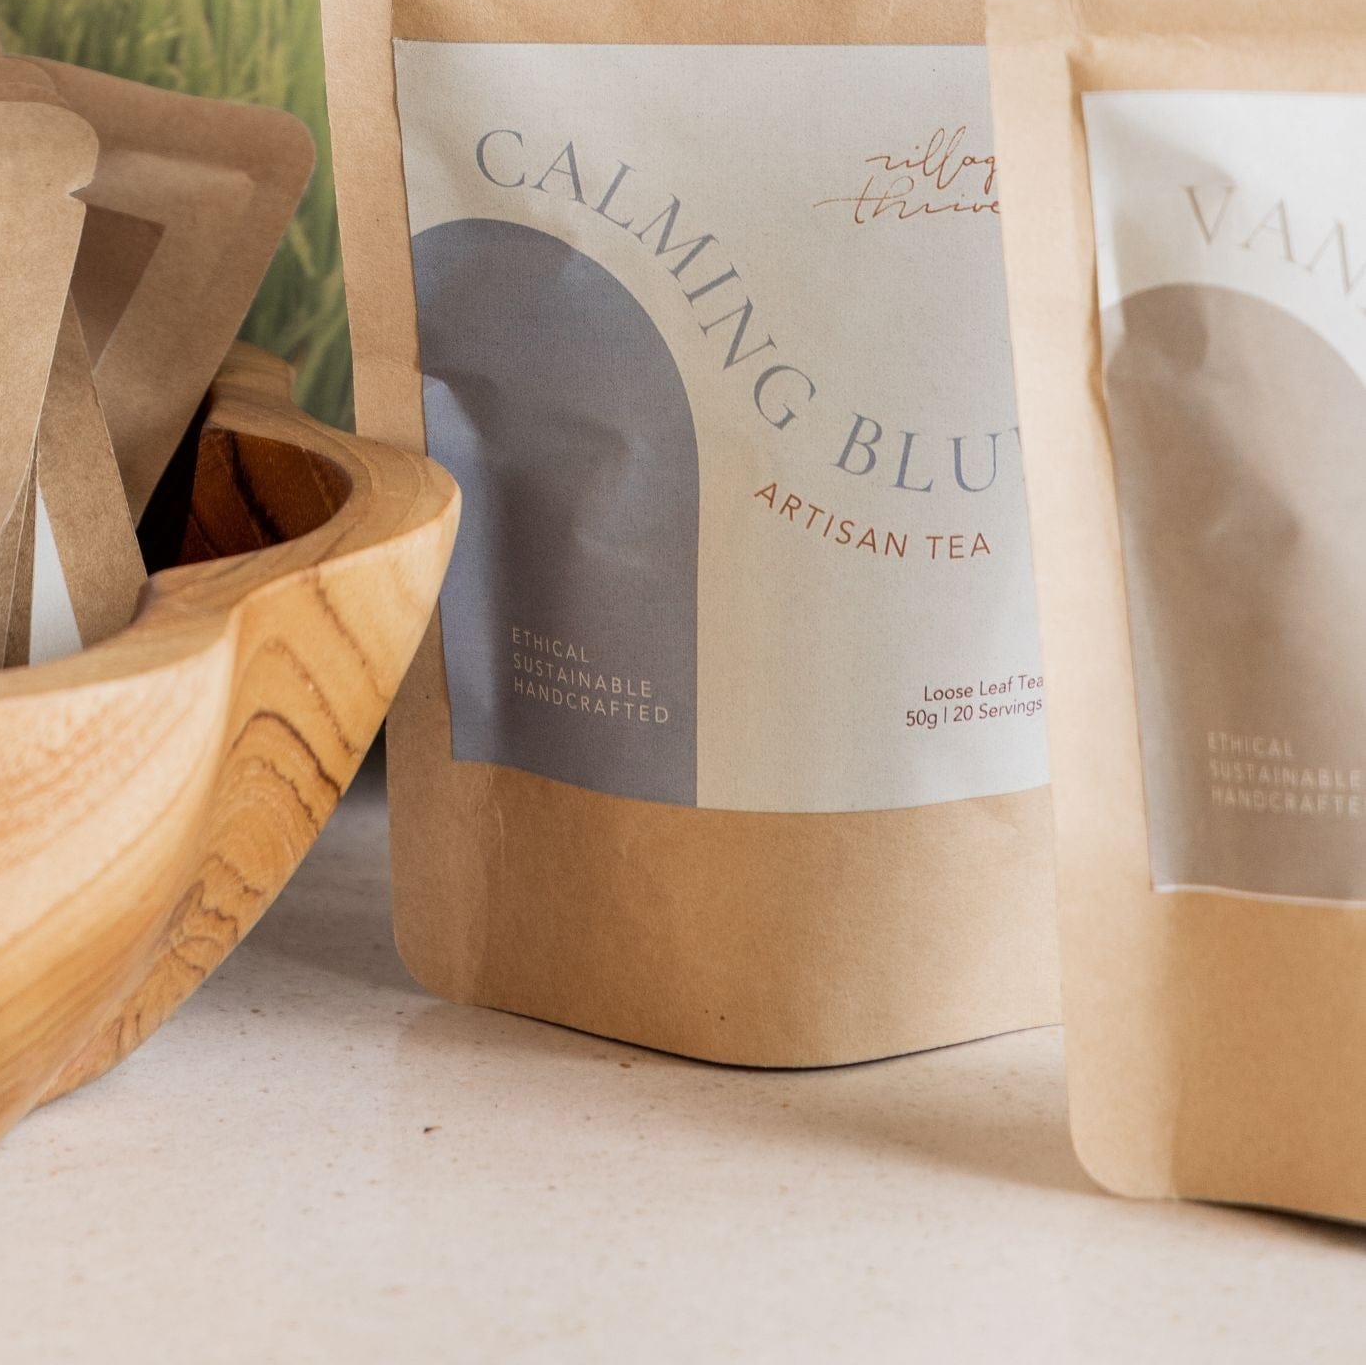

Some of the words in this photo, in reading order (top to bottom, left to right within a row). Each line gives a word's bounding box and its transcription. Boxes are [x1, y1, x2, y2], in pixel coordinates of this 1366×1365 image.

[865, 126, 998, 195] villag
[813, 175, 1001, 224] thrive
[1179, 183, 1366, 319] VAN
[475, 128, 817, 430] CALMING
[830, 412, 1022, 494] BLU
[754, 482, 909, 559] ARTISAN
[925, 532, 992, 560] TEA
[512, 627, 590, 663] ETHICAL
[513, 652, 652, 698] SUSTAINABLE
[924, 685, 974, 702] Loose
[979, 675, 1014, 696] Leaf
[1017, 674, 1044, 691] Tea
[514, 676, 669, 724] HANDCRAFTED
[906, 709, 938, 730] 50g
[953, 704, 974, 722] 20
[979, 699, 1043, 720] Servings
[1208, 731, 1293, 757] ETHICAL
[1209, 759, 1362, 789] SUSTAINABLE
[1212, 785, 1362, 817] HANDCRAFTE
